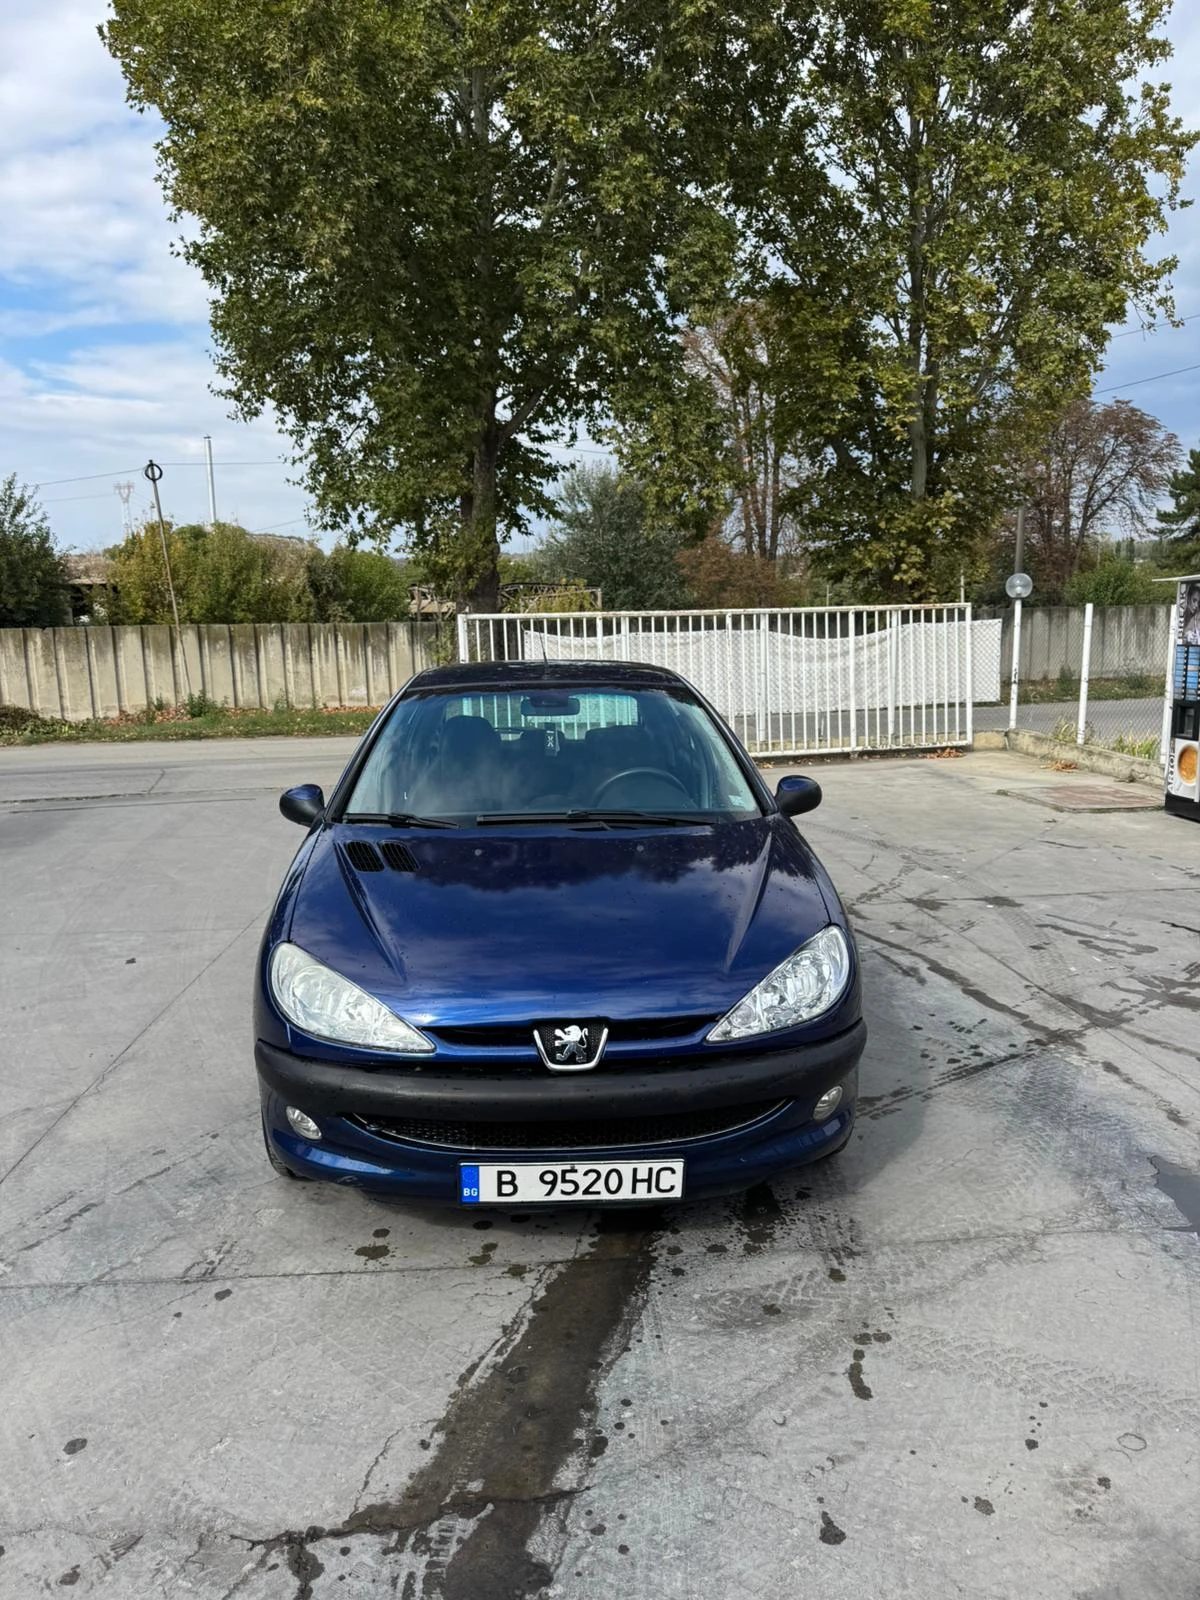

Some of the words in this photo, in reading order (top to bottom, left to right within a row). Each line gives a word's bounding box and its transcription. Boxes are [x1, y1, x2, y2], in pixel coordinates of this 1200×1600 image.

[497, 1170, 519, 1197] B
[539, 1168, 623, 1197] 9520
[631, 1166, 676, 1194] HC
[463, 1187, 478, 1197] BG
